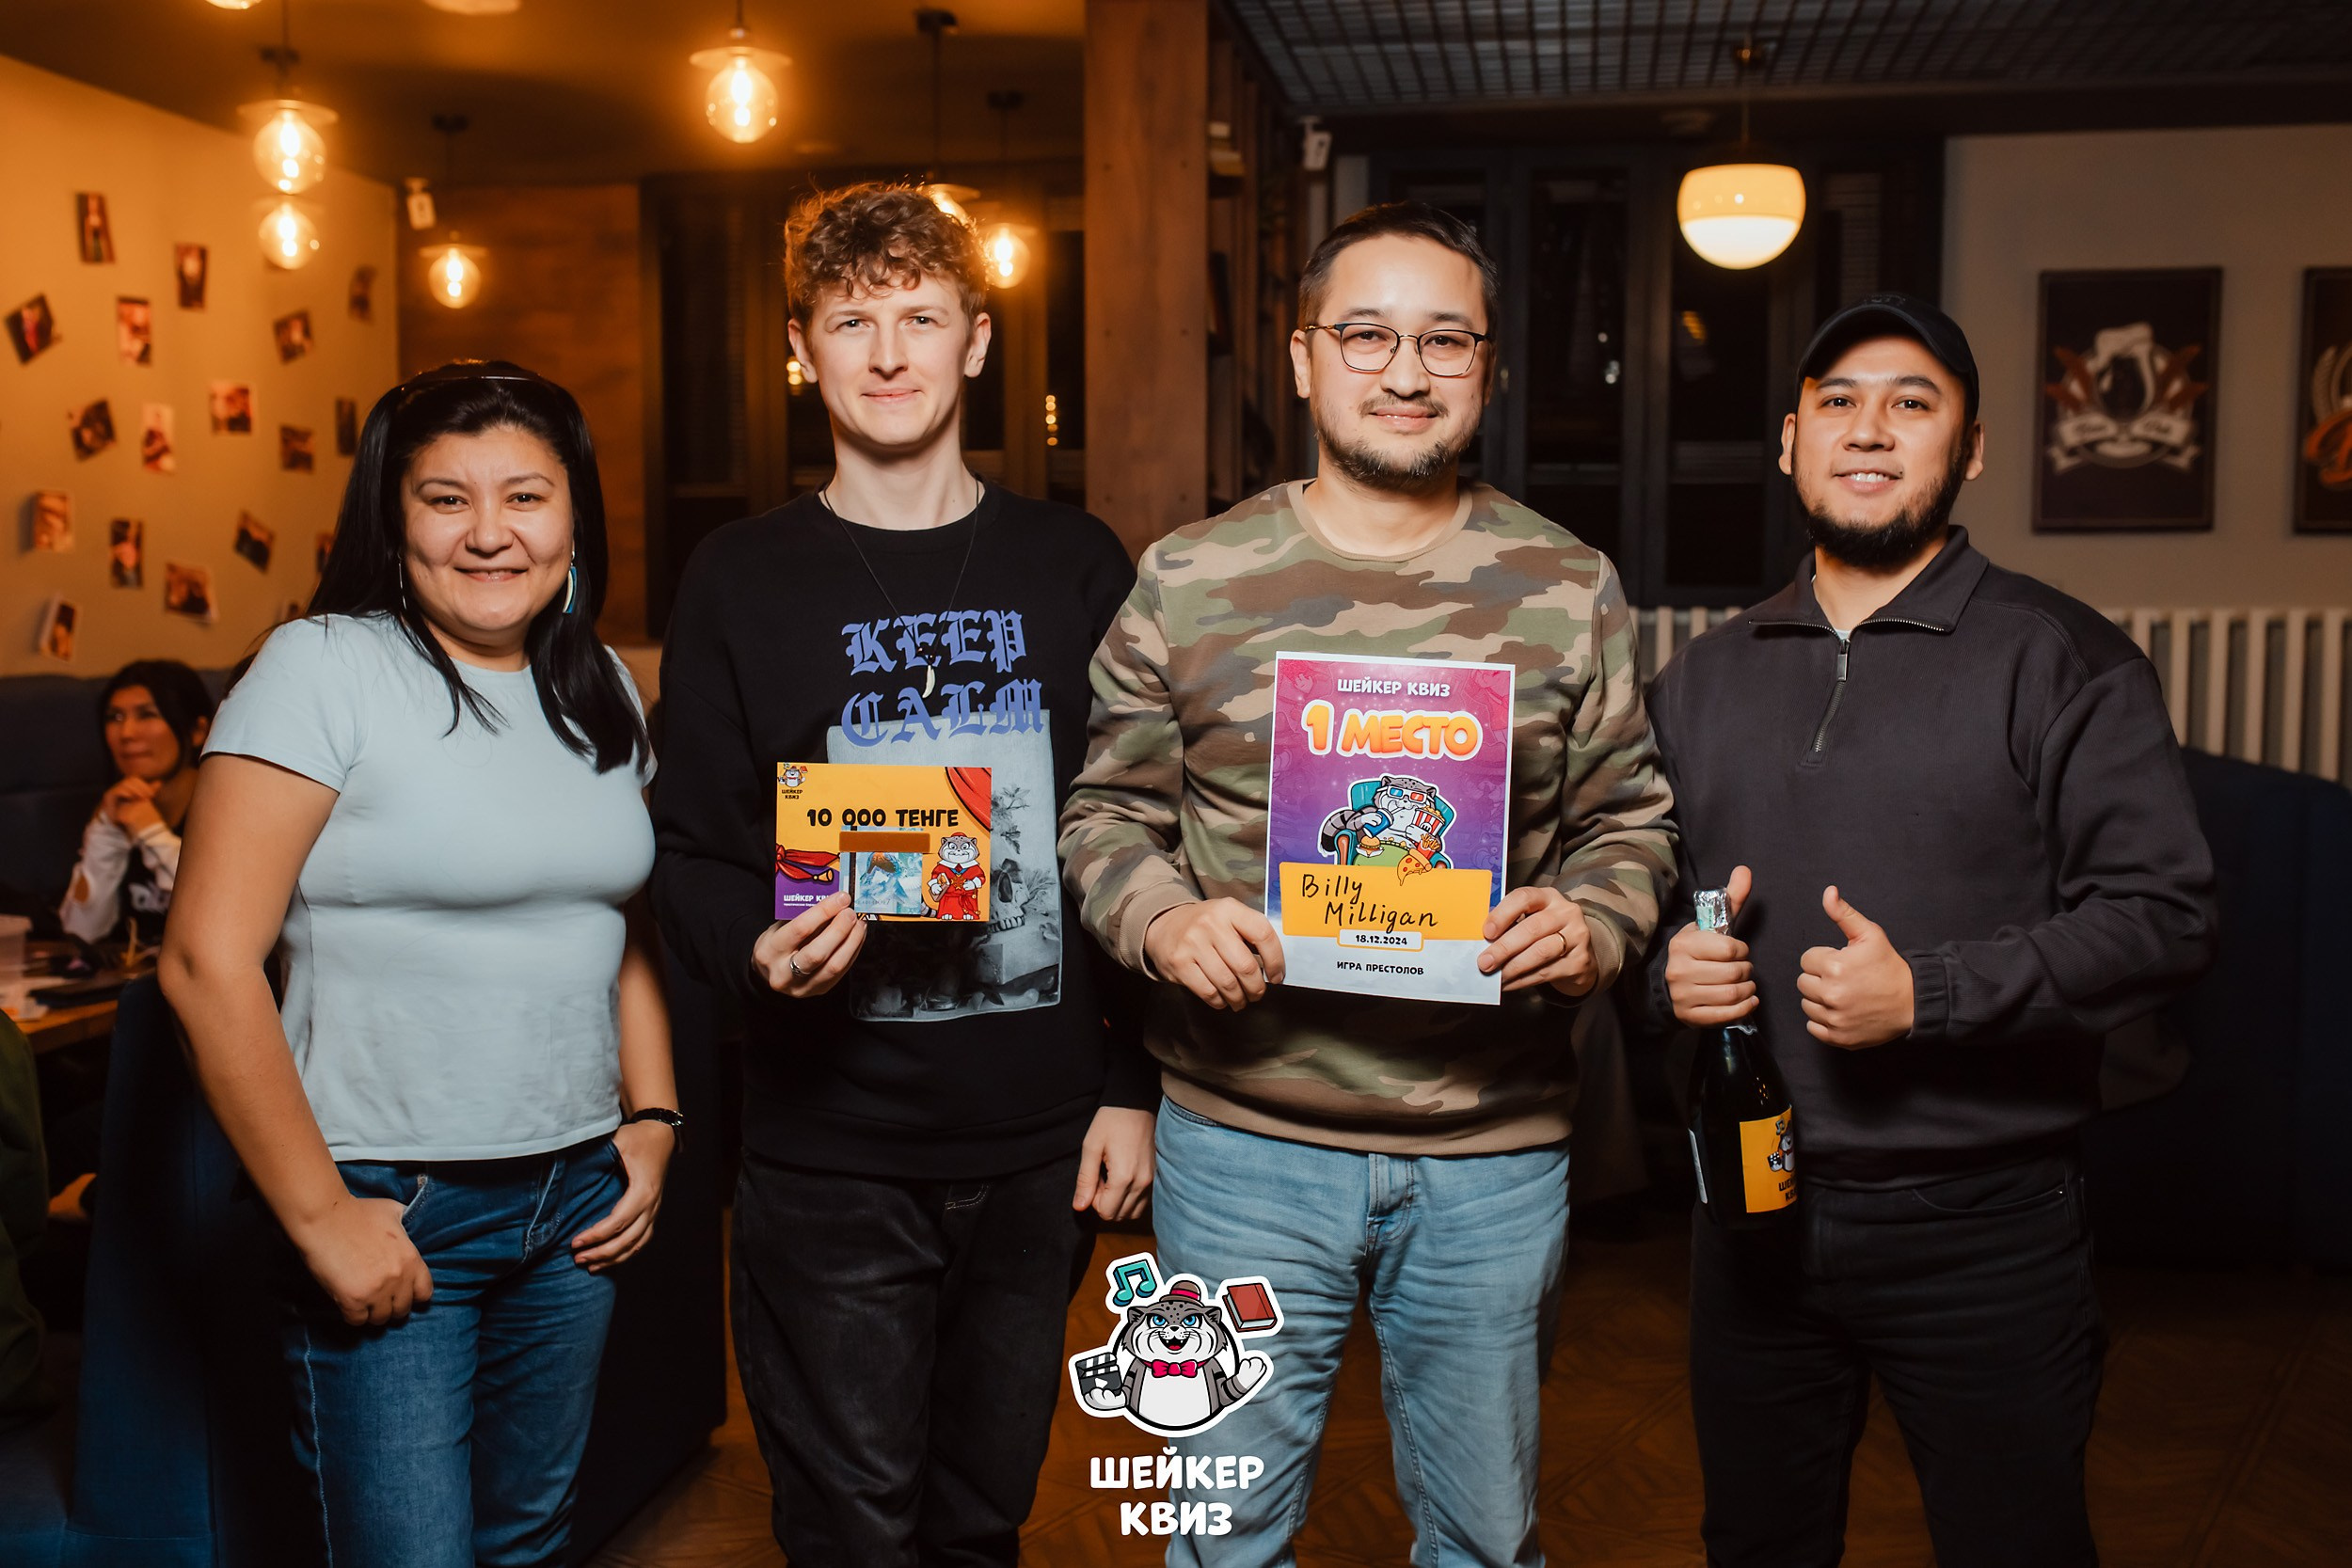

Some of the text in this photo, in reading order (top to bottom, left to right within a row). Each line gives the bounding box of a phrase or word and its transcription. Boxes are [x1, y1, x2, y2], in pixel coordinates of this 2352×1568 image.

[841, 610, 1027, 675] KEEP
[1337, 675, 1451, 697] ШЕЙКЕР КВИЗ
[840, 678, 1044, 748] CALM
[1305, 704, 1479, 757] 1 МЕСТО
[806, 808, 959, 828] 10 000 ТЕНГЕ
[783, 893, 814, 902] ШЕЙКЕР
[1302, 874, 1363, 904] Billy
[1324, 901, 1438, 934] Milligan
[1355, 934, 1408, 946] 18.12.2024
[1336, 960, 1424, 975] ИГРА ПРЕСТОЛОВ
